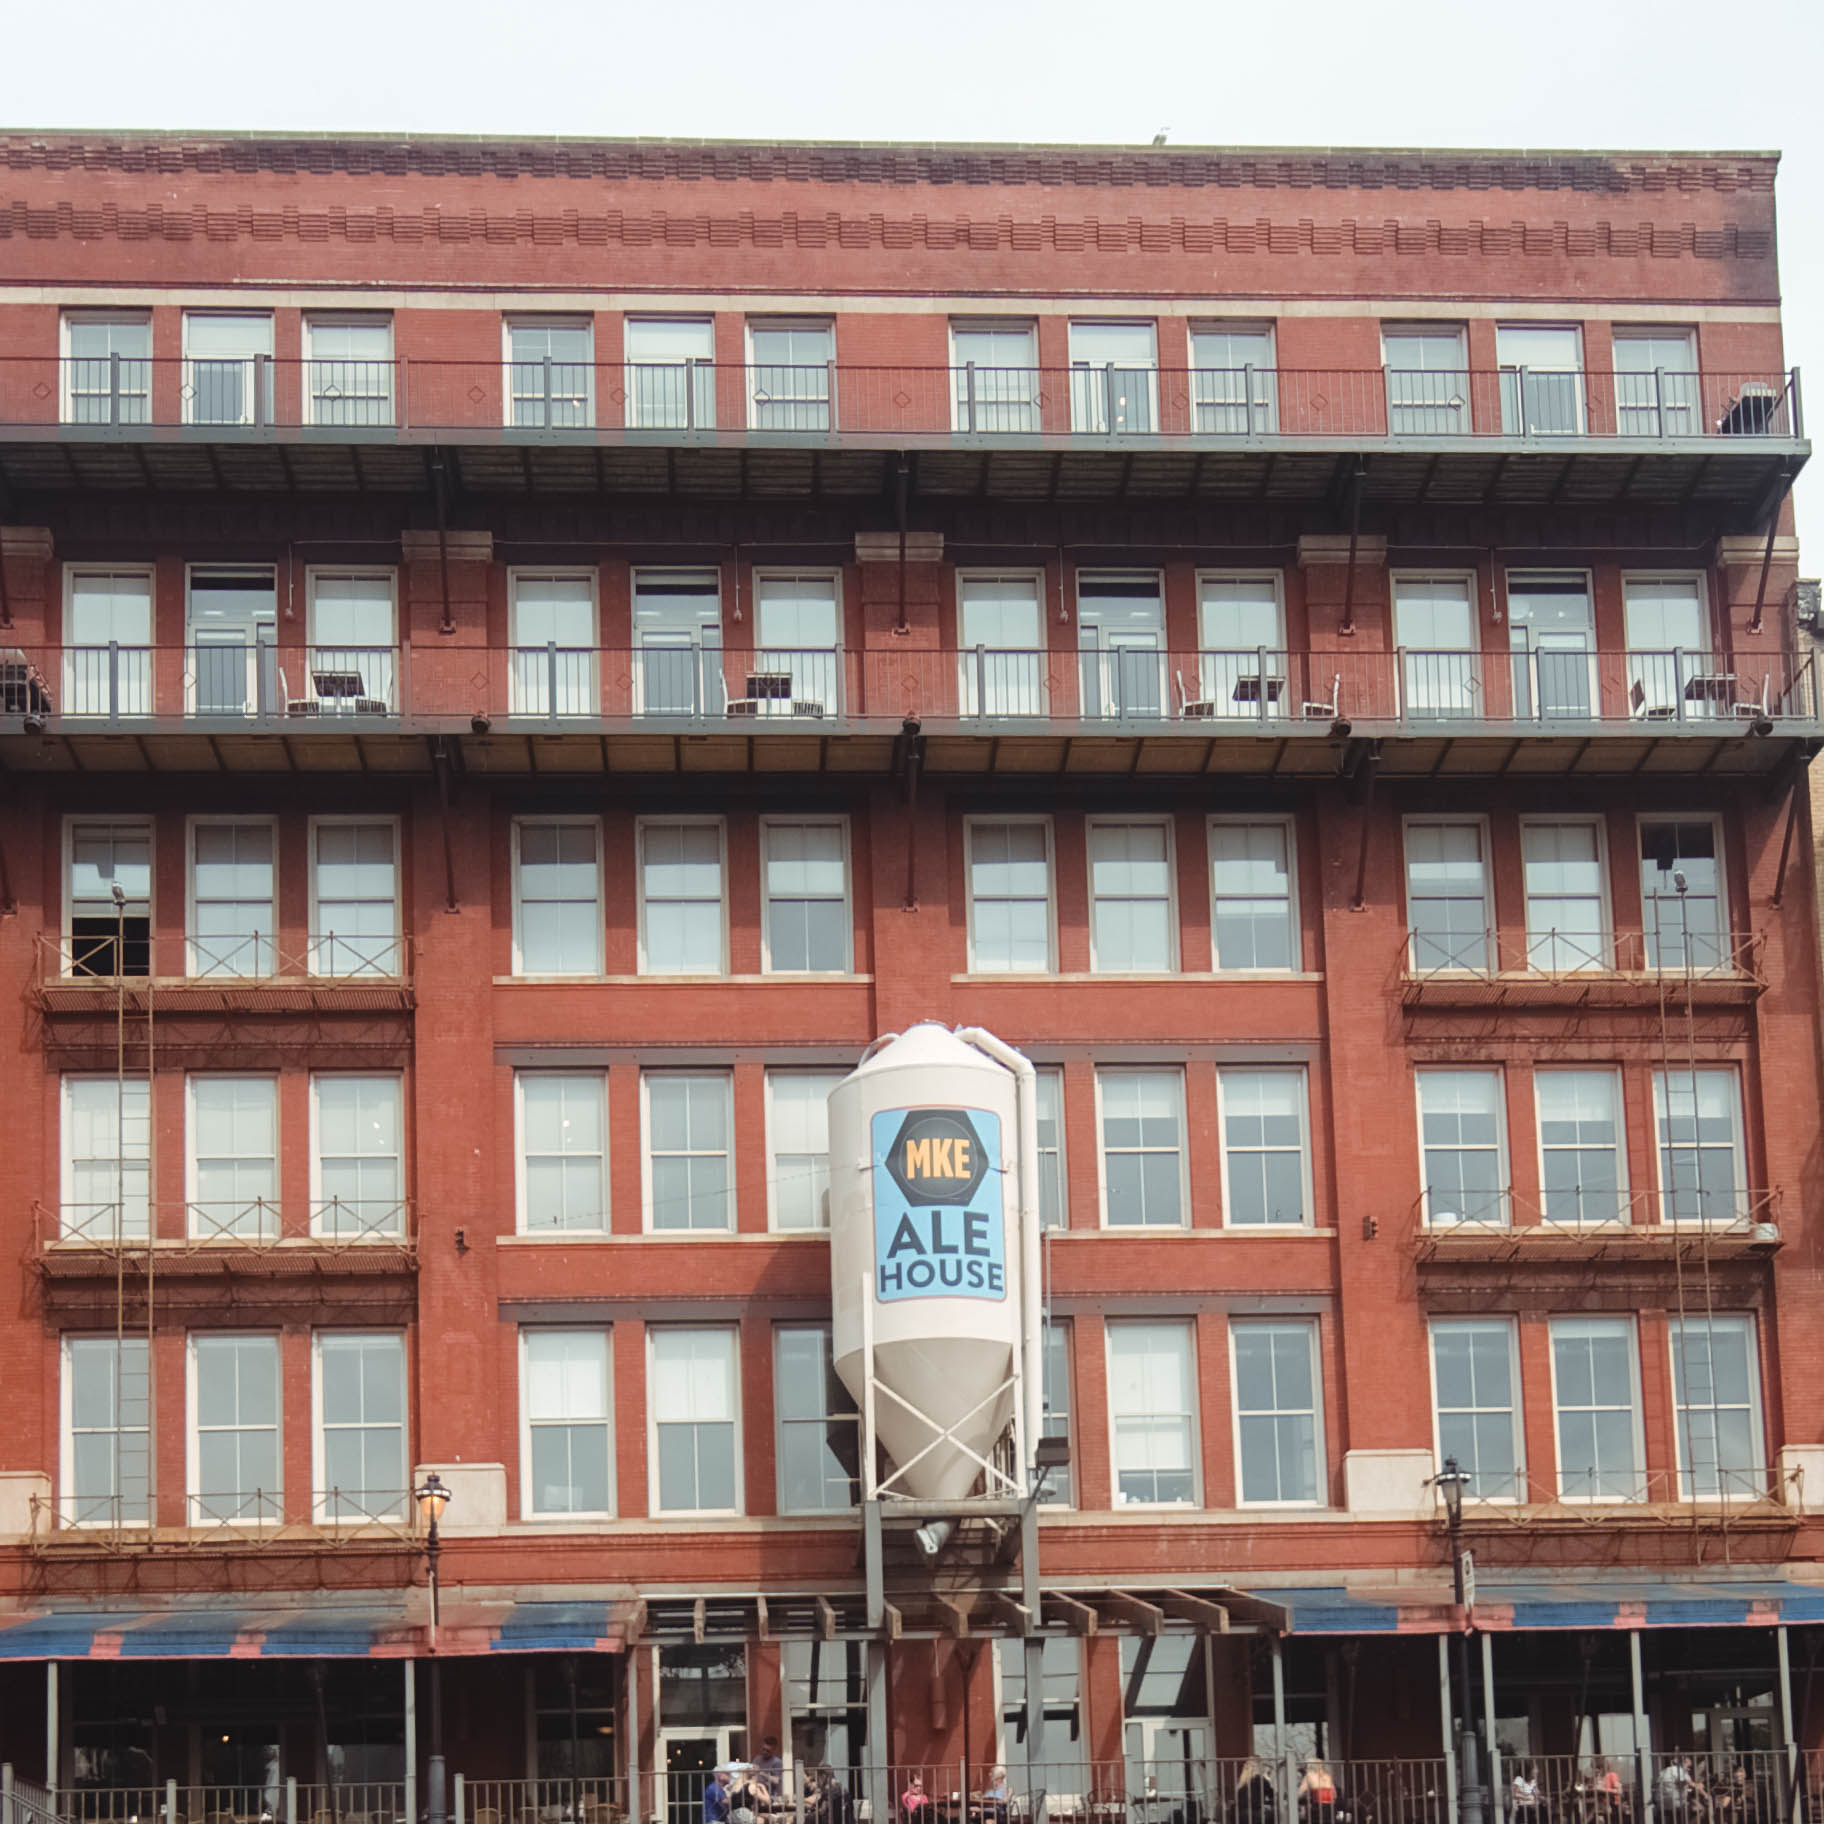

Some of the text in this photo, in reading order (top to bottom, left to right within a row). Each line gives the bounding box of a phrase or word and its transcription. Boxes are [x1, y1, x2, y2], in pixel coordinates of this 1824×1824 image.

[906, 1138, 971, 1180] MKE
[886, 1210, 991, 1259] ALE
[880, 1258, 1004, 1293] HOUSE
